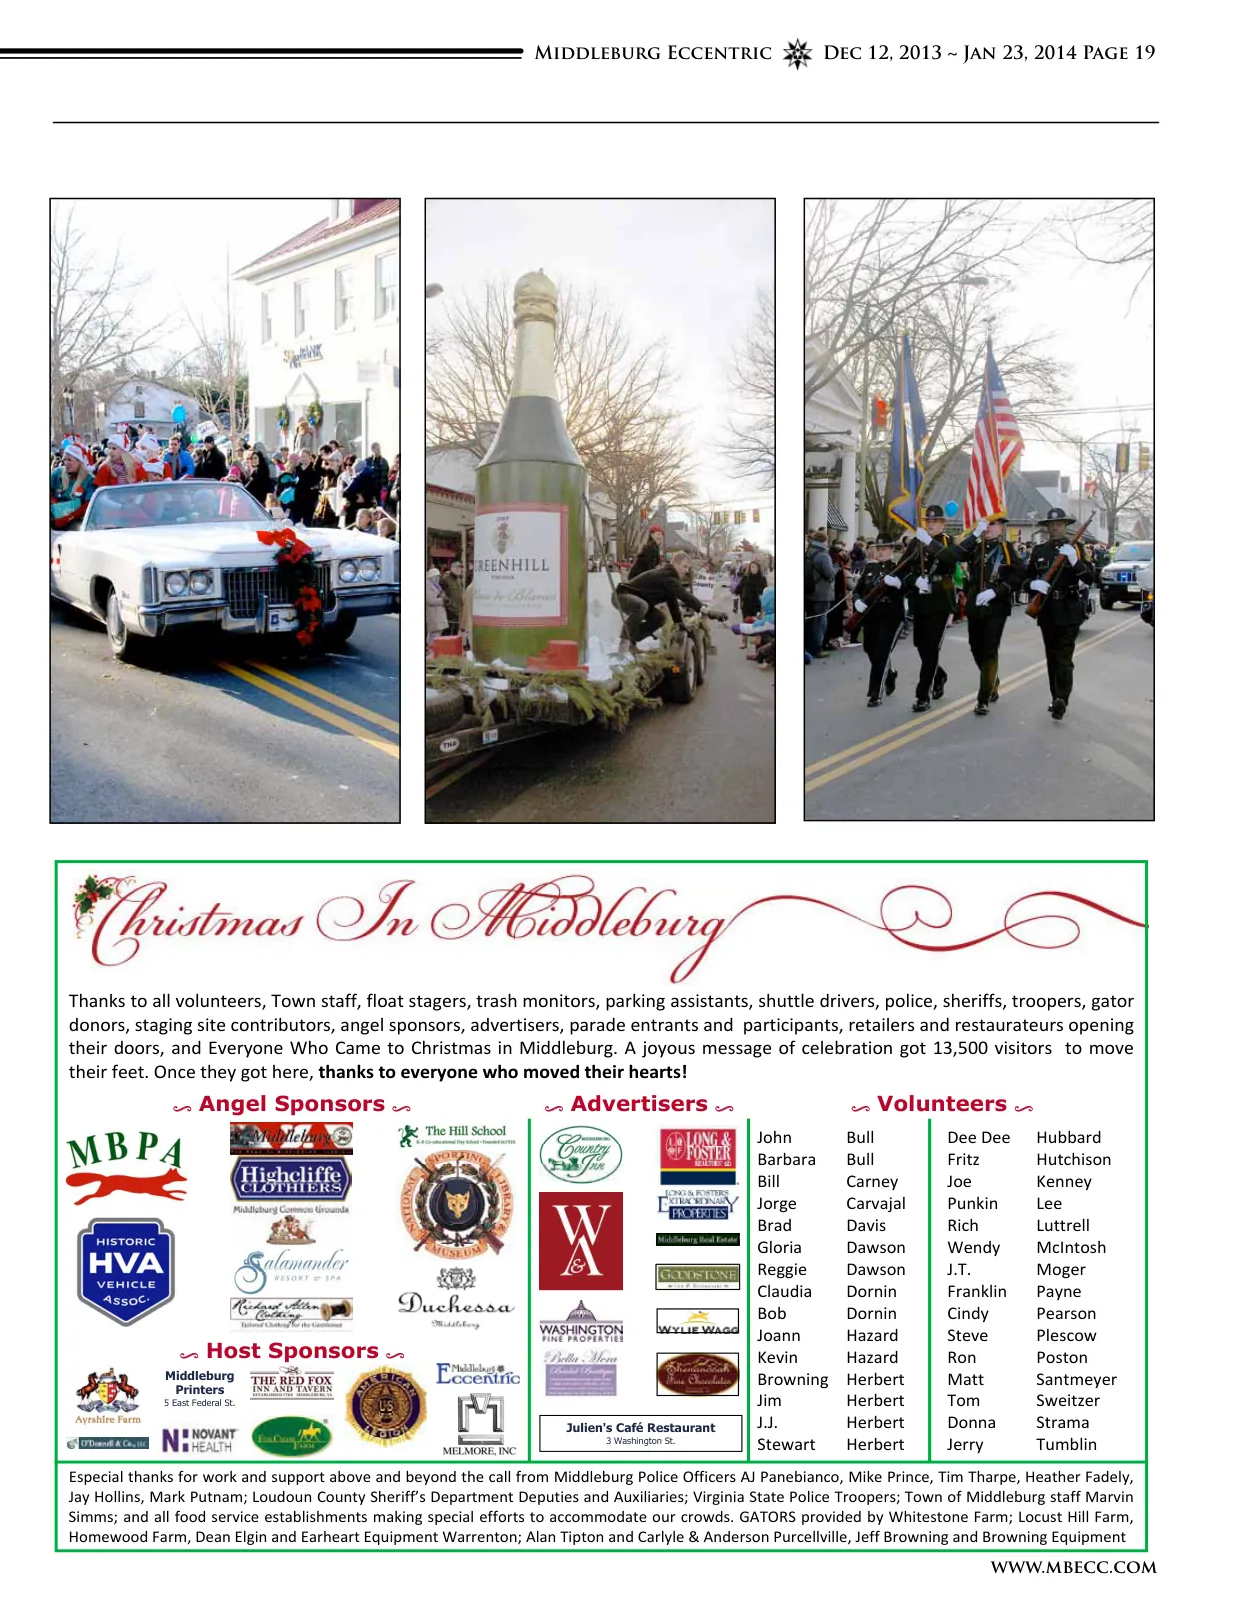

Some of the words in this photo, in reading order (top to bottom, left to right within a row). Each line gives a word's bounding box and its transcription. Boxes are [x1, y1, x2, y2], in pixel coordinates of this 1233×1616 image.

[825, 45, 861, 59] DEC
[870, 45, 892, 60] 12,
[900, 45, 941, 59] 2013
[964, 45, 995, 63] JAN
[1003, 45, 1027, 61] 23,
[1035, 45, 1077, 59] 2014
[1084, 45, 1128, 59] PAGE
[1137, 45, 1155, 59] 19
[92, 881, 304, 967] Christmas
[316, 879, 418, 941] In
[430, 874, 756, 984] Middleburg
[70, 1065, 107, 1078] their
[112, 1065, 148, 1078] feet.
[155, 1065, 195, 1078] Once
[201, 1065, 236, 1081] they
[241, 1067, 267, 1082] got
[273, 1065, 313, 1081] here,
[319, 1065, 373, 1078] thanks
[379, 1067, 395, 1078] to
[401, 1069, 477, 1082] everyone
[483, 1065, 518, 1078] who
[524, 1065, 579, 1078] moved
[585, 1065, 624, 1078] their
[630, 1065, 686, 1078] hearts!
[199, 1095, 266, 1116] Angel
[275, 1095, 385, 1115] Sponsors
[571, 1095, 707, 1112] Advertisers
[877, 1095, 1007, 1112] Volunteers
[426, 1126, 446, 1136] The
[449, 1126, 468, 1136] Hill
[471, 1126, 506, 1136] School
[757, 1131, 791, 1143] John
[848, 1131, 873, 1143] Bull
[1038, 1131, 1100, 1143] Hubbard
[687, 1132, 717, 1146] LONG
[949, 1132, 976, 1143] Dee
[982, 1132, 1010, 1143] Dee
[66, 1131, 181, 1168] MBPA
[687, 1146, 732, 1160] FOSTER
[241, 1166, 341, 1185] Highcliffe
[241, 1182, 342, 1193] CLOTHIERS
[757, 1198, 796, 1212] Jorge
[847, 1197, 905, 1212] Carvajal
[96, 1237, 156, 1246] HISTORIC
[1038, 1241, 1105, 1253] McIntosh
[948, 1241, 1000, 1256] Wendy
[89, 1252, 165, 1274] HVA
[97, 1281, 156, 1289] VEHICLE
[103, 1295, 150, 1307] ASSOC.
[398, 1291, 516, 1313] Duchessa
[539, 1325, 624, 1335] WASHINGTON
[208, 1343, 261, 1359] Host
[269, 1342, 378, 1362] Sponsors
[166, 1371, 234, 1383] Middleburg
[251, 1376, 276, 1385] THE
[280, 1376, 304, 1385] RED
[308, 1376, 332, 1385] FOX
[176, 1385, 224, 1394] Printers
[75, 1415, 116, 1425] Ayrshire
[118, 1415, 141, 1424] Farm
[566, 1422, 612, 1433] Julien's
[615, 1421, 644, 1433] Café
[647, 1422, 716, 1433] Restaurant
[192, 1429, 235, 1439] NOVANT
[192, 1441, 232, 1452] HEALTH
[614, 1437, 662, 1446] Washington
[758, 1438, 815, 1450] Stewart
[848, 1438, 904, 1450] Herbert
[947, 1439, 983, 1453] Jerry
[1036, 1438, 1096, 1450] Tumblin
[499, 1447, 516, 1455] INC
[70, 1531, 147, 1542] Homewood
[153, 1532, 190, 1544] Farm,
[197, 1532, 230, 1542] Dean
[236, 1531, 266, 1545] Elgin
[272, 1531, 296, 1542] and
[302, 1531, 359, 1542] Earheart
[365, 1531, 438, 1545] Equipment
[443, 1531, 521, 1544] Warrenton;
[526, 1531, 555, 1542] Alan
[560, 1531, 603, 1545] Tipton
[609, 1531, 633, 1542] and
[638, 1531, 684, 1545] Carlyle
[689, 1531, 699, 1542] &
[704, 1531, 768, 1542] Anderson
[775, 1531, 851, 1544] Purcellville,
[856, 1531, 880, 1542] Jeff
[885, 1531, 948, 1545] Browning
[953, 1531, 977, 1542] and
[983, 1531, 1047, 1545] Browning
[1053, 1531, 1126, 1545] Equipment
